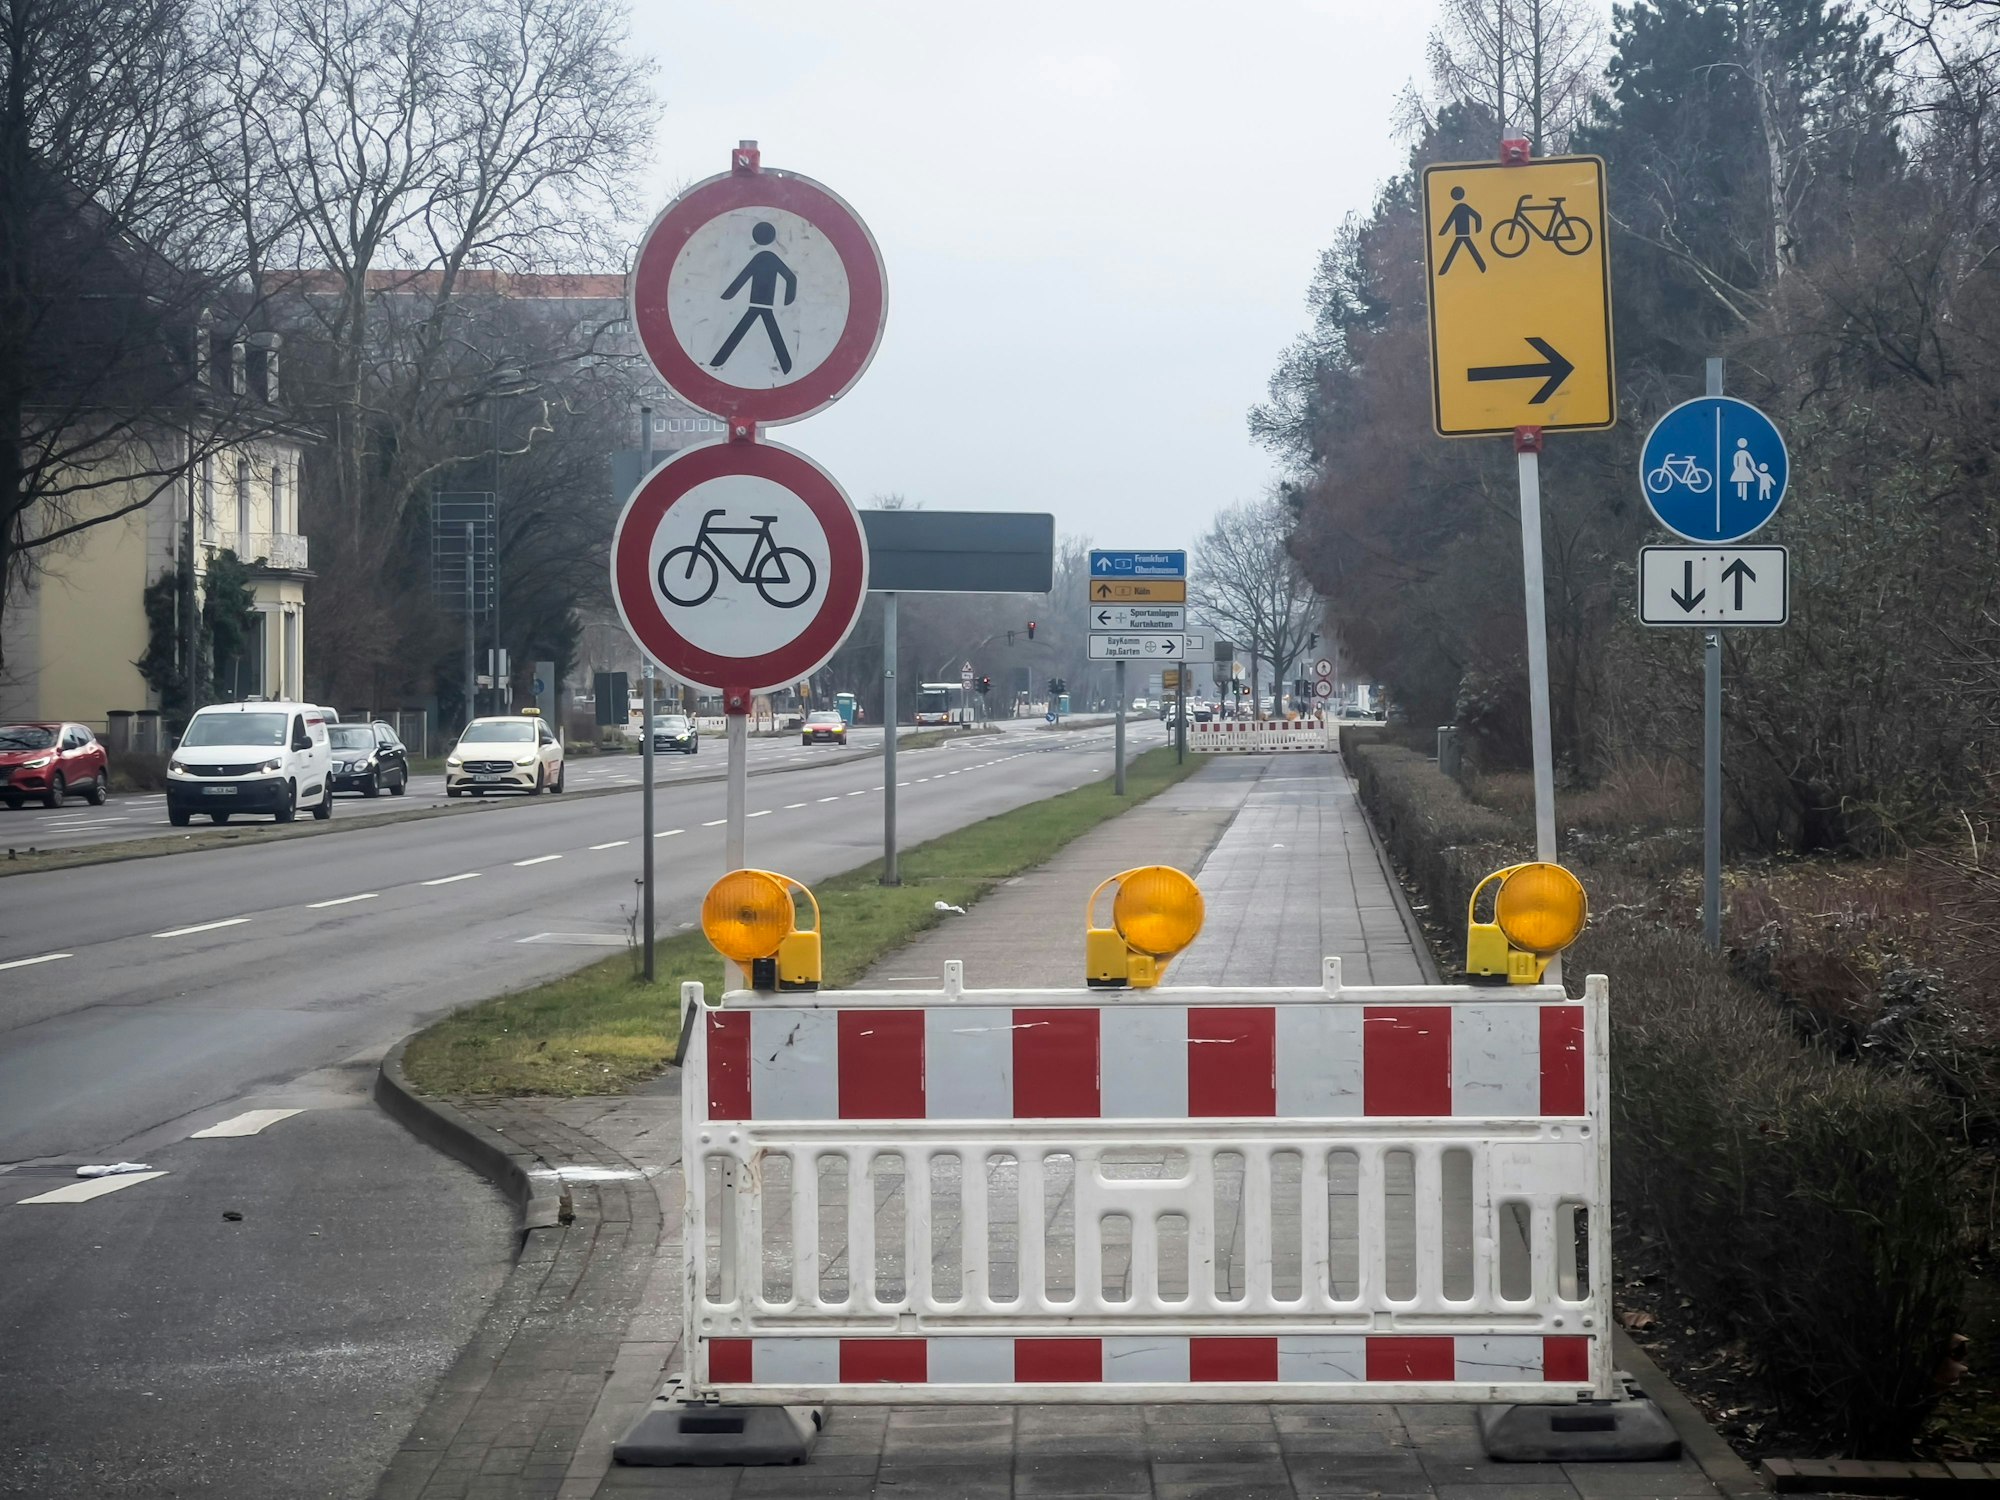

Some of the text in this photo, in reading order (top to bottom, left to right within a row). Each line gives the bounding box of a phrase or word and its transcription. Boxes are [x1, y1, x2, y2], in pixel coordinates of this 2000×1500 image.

[1135, 554, 1168, 562] Frankfurt
[1134, 587, 1151, 595] Köln
[1130, 609, 1179, 618] Sportanlagen
[1107, 637, 1140, 646] BayKomm
